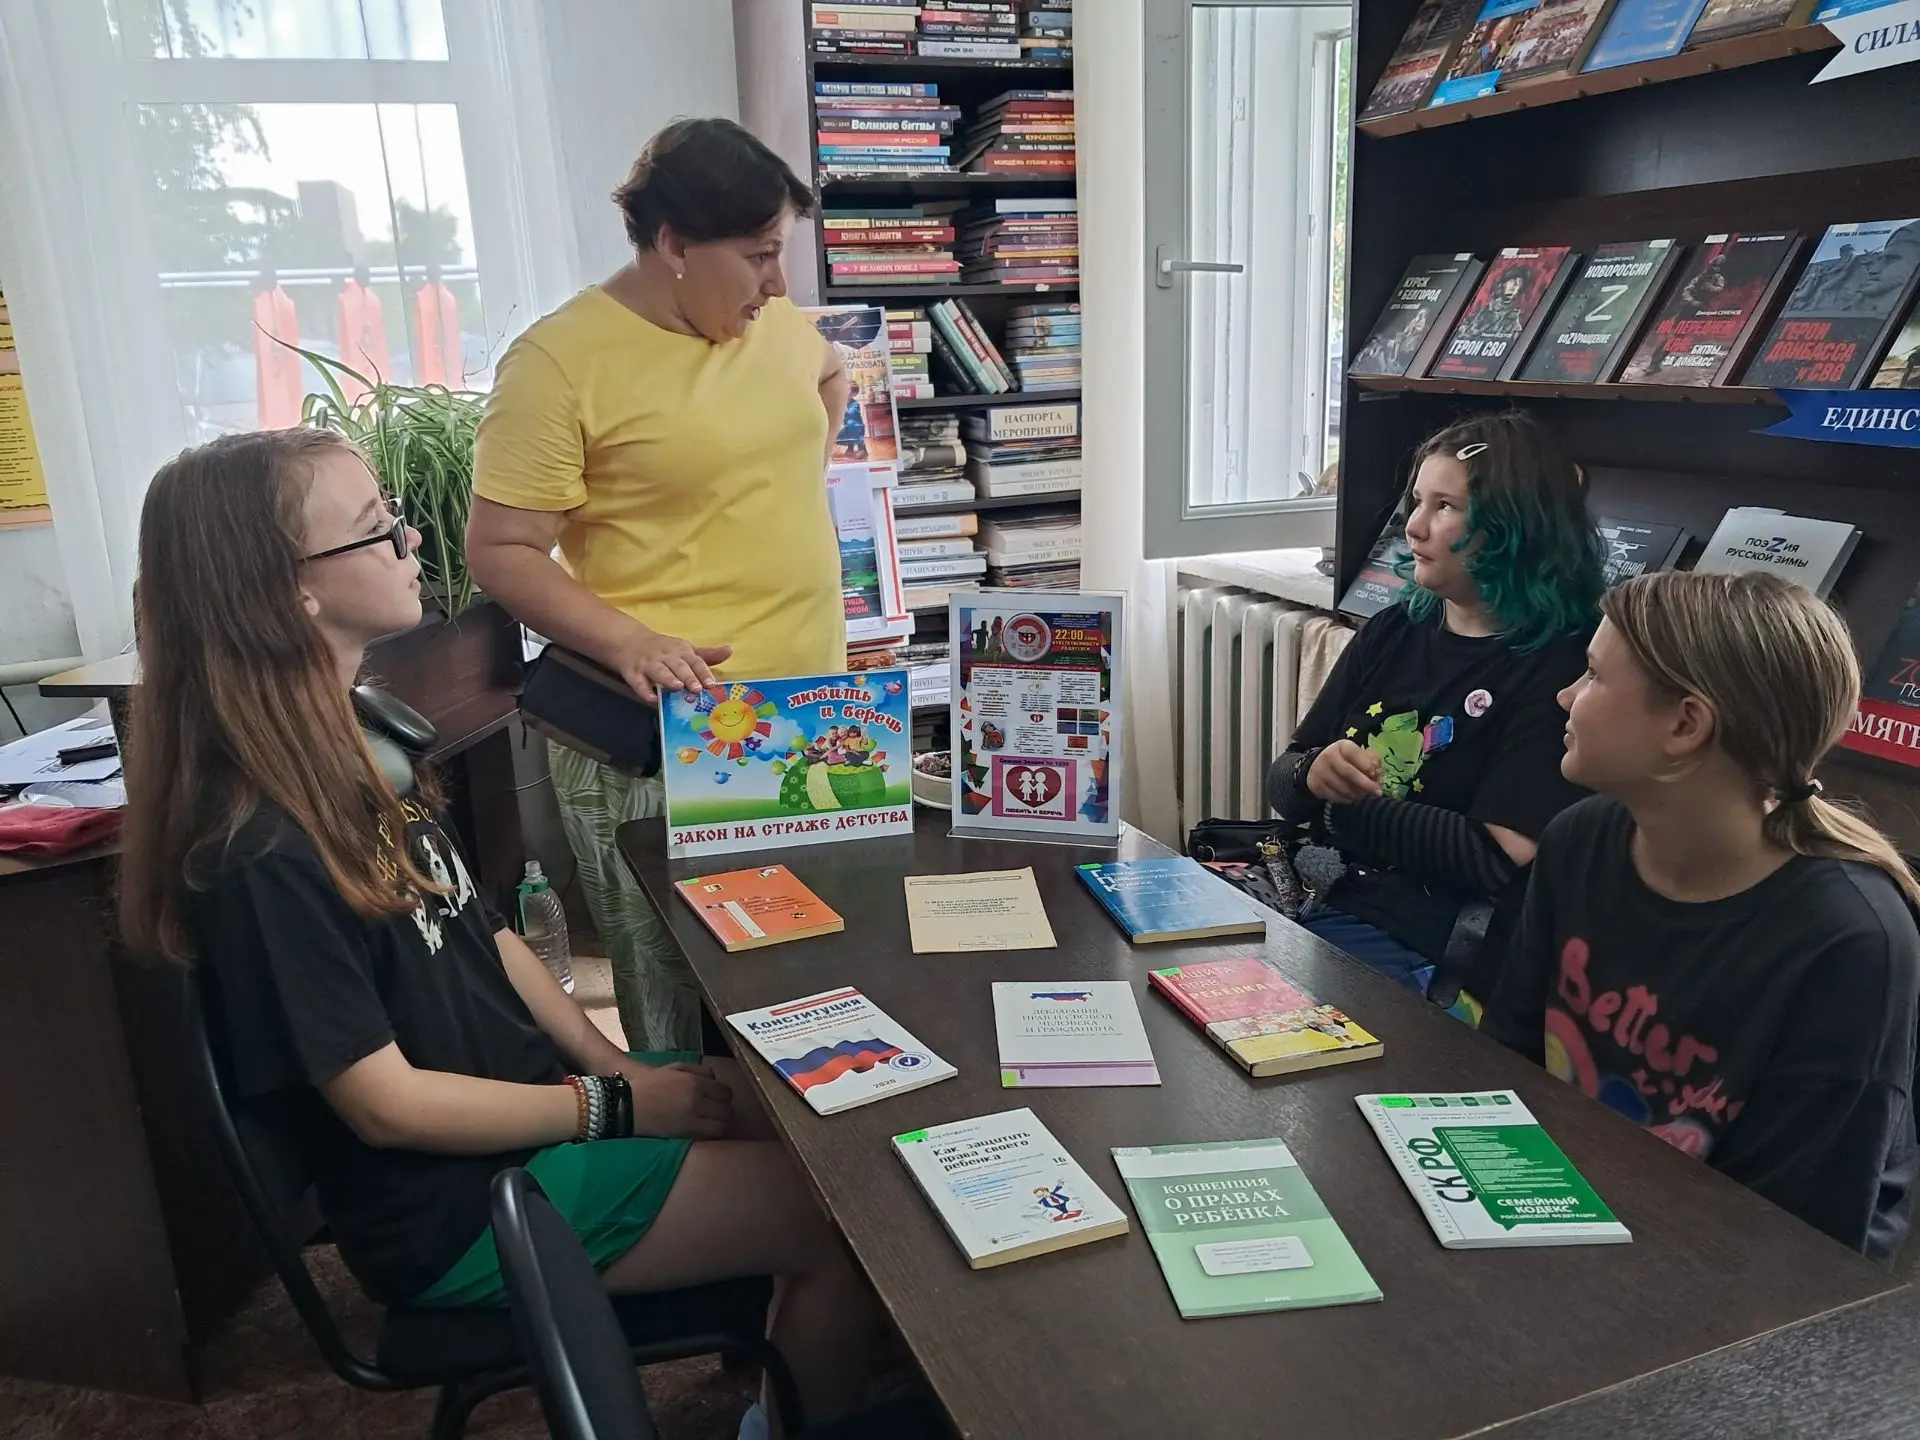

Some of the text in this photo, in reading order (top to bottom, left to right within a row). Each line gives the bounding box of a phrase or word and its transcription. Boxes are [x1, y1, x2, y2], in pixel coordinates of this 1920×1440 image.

[851, 119, 900, 131] Великие
[901, 120, 936, 132] битвы
[841, 231, 866, 241] КНИГА
[1584, 262, 1653, 279] НОВОРОССИЯ
[1584, 284, 1628, 322] Z
[1779, 322, 1832, 339] ГЕРОИ
[863, 350, 882, 360] СЕБЯ
[1448, 340, 1507, 357] ГЕРОИ СВО
[1690, 344, 1723, 356] БИТВЫ
[1764, 342, 1857, 363] ДОНБАССА
[1662, 355, 1715, 368] ЗА ДОНБАСС
[1808, 363, 1845, 382] СВО
[1004, 411, 1062, 425] ПАСПОРТА
[1820, 406, 1920, 432] ЕДИНС
[992, 424, 1074, 439] МЕРОПРИЯТИЙ
[1725, 547, 1809, 569] РУССКОЙ ЗИМЫ
[1055, 630, 1084, 641] 22:00
[788, 685, 874, 709] любить
[820, 704, 904, 735] и беречь
[1005, 807, 1032, 815] ЛЮБИТЬ
[1039, 809, 1063, 817] БЕРЕЧЬ
[673, 809, 910, 846] ЗАКОН НА СТРАЖЕ ДЕТСТВА
[1171, 966, 1234, 982] ЗАЩИТА
[1179, 978, 1219, 991] ПРАВ
[746, 998, 862, 1032] Конституция
[754, 1004, 867, 1036] Российской Федерации
[933, 1144, 960, 1157] Как
[968, 1130, 1031, 1150] защитить
[938, 1138, 1029, 1164] права своего
[943, 1153, 1002, 1173] ребенка
[1407, 1137, 1449, 1171] РФ
[1161, 1177, 1269, 1195] КОНВЕНЦИЯ
[1428, 1174, 1477, 1203] СК
[1164, 1188, 1284, 1210] О ПРАВАХ
[1496, 1195, 1580, 1207] СЕМЕЙНЫЙ
[1173, 1203, 1291, 1226] РЕБЁНКА
[1513, 1205, 1572, 1214] КОДЕКС
